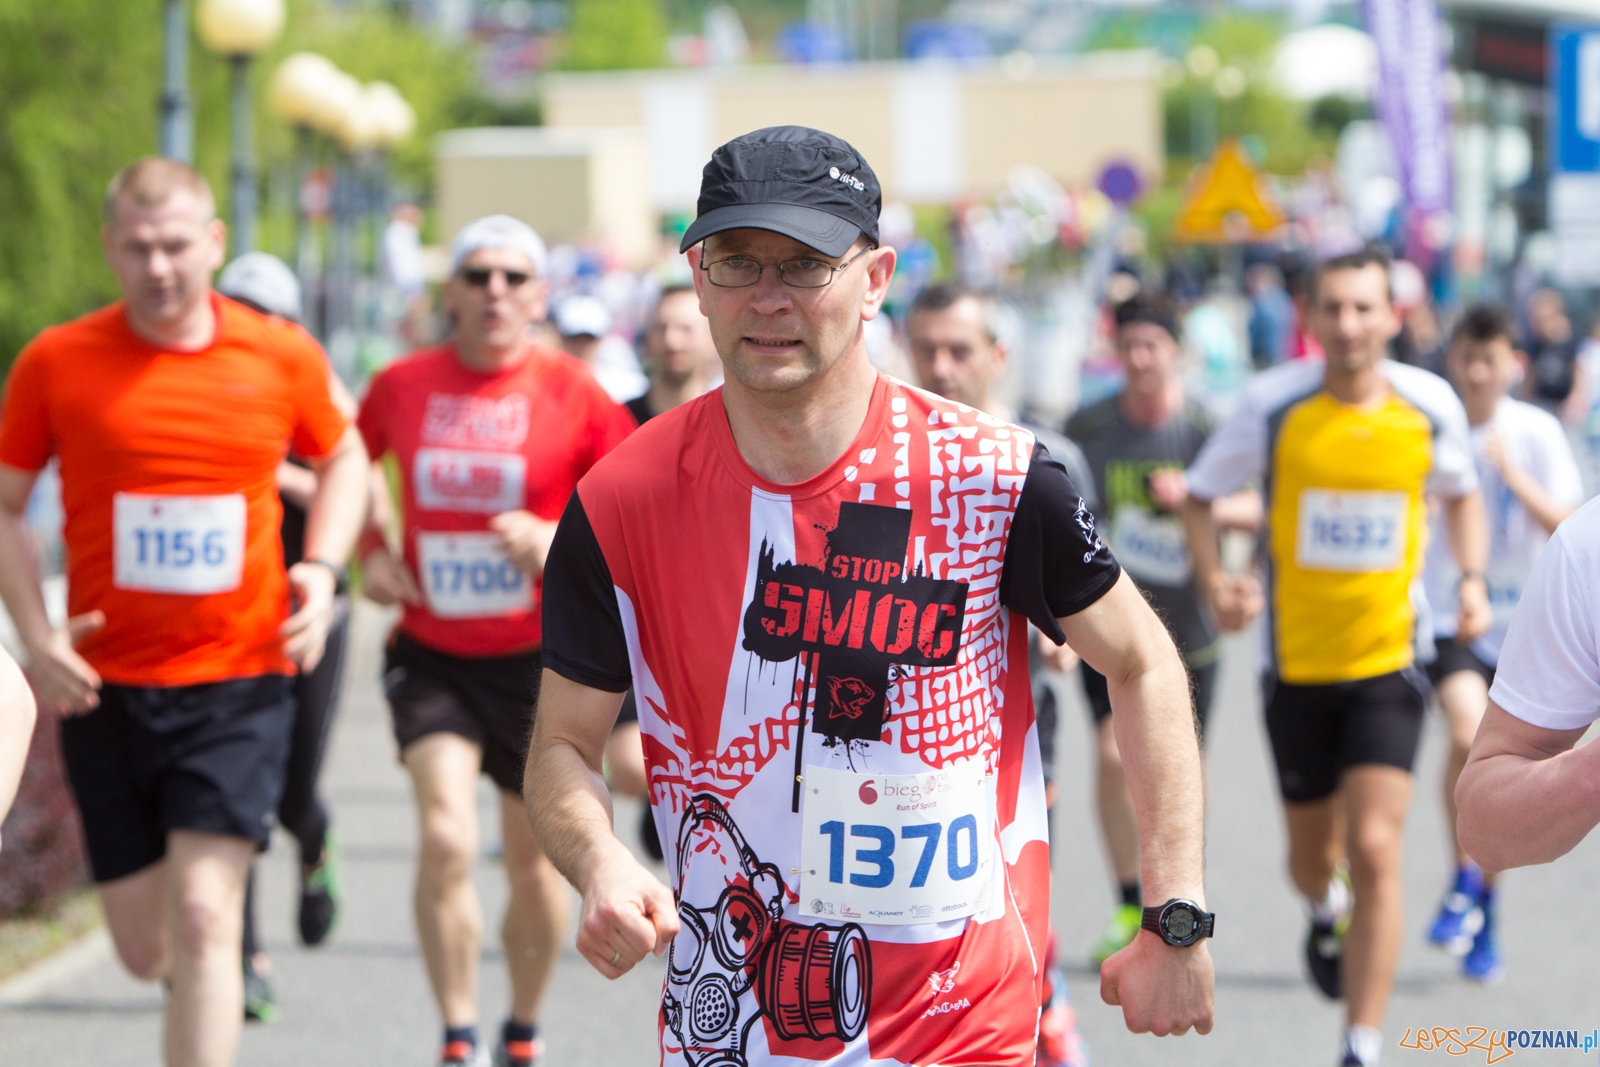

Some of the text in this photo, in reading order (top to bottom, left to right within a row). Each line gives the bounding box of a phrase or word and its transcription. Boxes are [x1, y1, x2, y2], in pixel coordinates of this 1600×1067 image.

[133, 527, 225, 568] 1156
[430, 559, 523, 596] 1700
[832, 554, 901, 585] STOP
[760, 581, 957, 659] SMOG
[858, 779, 922, 805] 6 bieg
[896, 801, 937, 812] Run of Spirit
[819, 813, 979, 889] 1370
